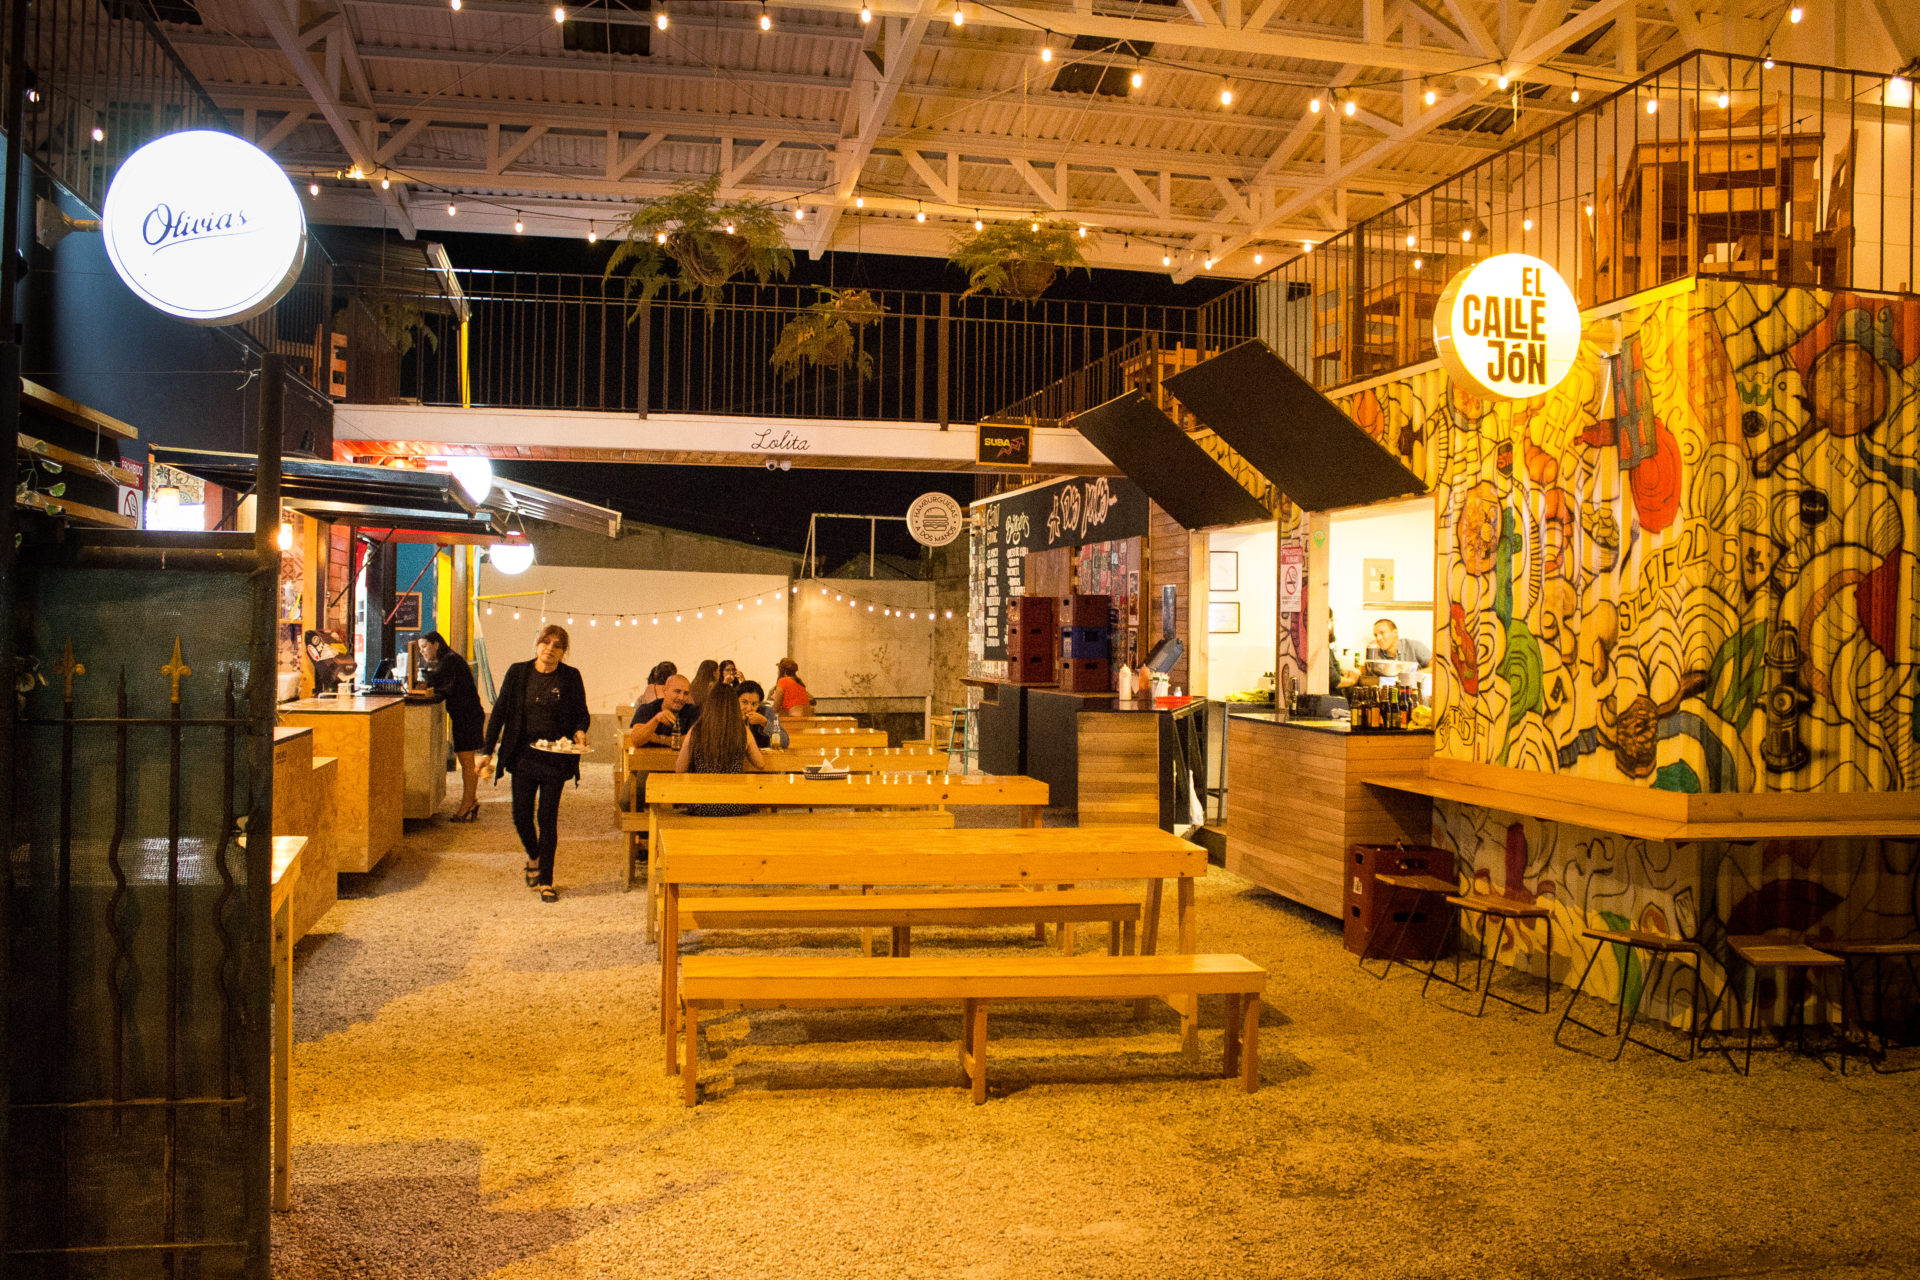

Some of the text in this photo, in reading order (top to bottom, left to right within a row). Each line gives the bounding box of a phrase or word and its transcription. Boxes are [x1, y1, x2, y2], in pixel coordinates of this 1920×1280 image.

[142, 202, 248, 246] Olivias
[1522, 266, 1547, 298] EL
[1462, 293, 1547, 342] CALLE
[751, 428, 811, 451] Lolita
[984, 437, 1011, 447] SUBA
[914, 496, 958, 518] HAMBURGUESAS
[920, 530, 933, 541] DOS
[934, 526, 956, 542] MANOS
[1619, 552, 1661, 632] STEET
